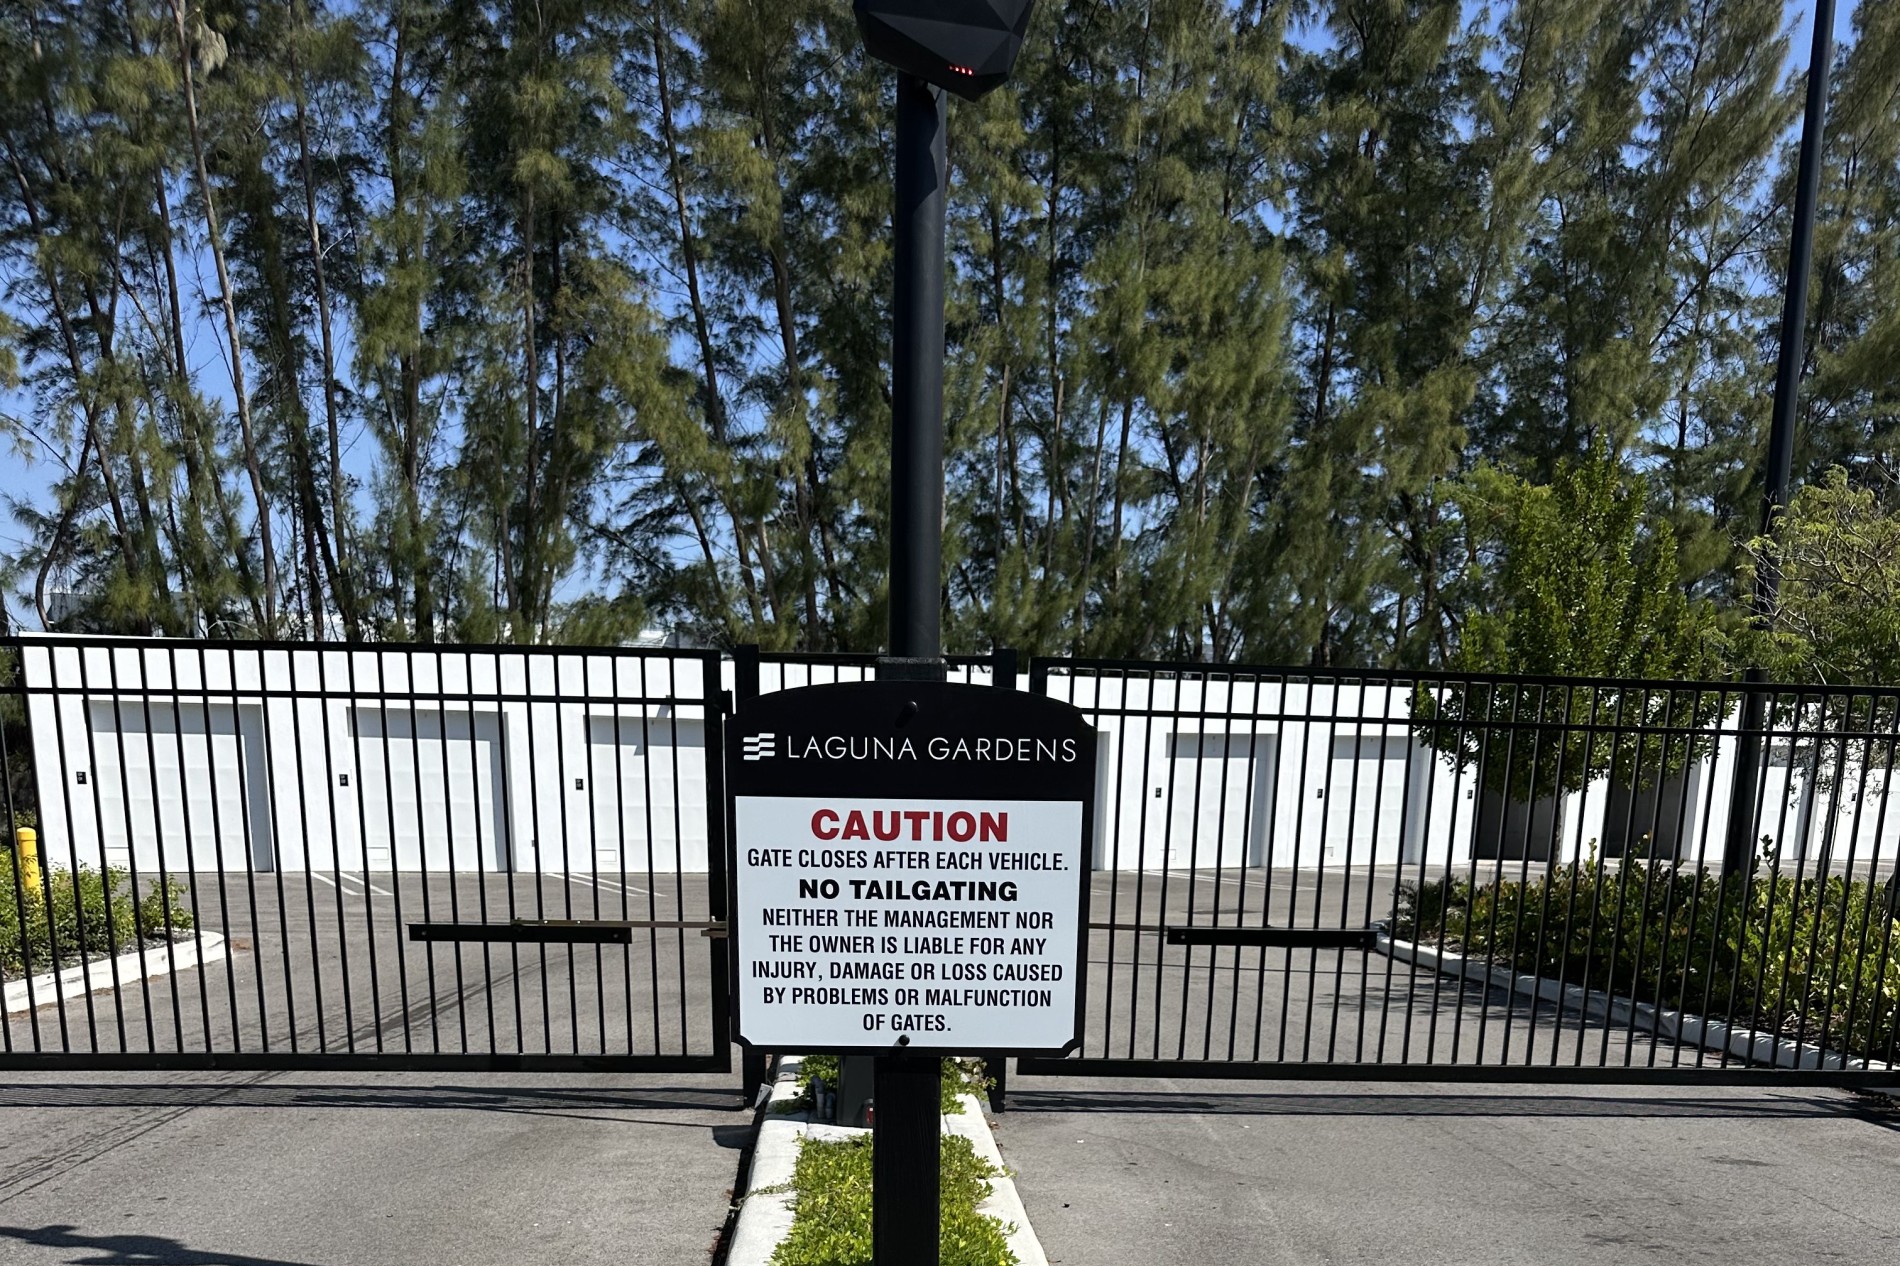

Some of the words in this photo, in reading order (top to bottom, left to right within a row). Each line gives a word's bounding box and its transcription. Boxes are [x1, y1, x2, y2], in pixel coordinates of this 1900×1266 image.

[788, 736, 916, 760] LAGUNA
[928, 738, 1076, 762] GARDENS
[812, 809, 1007, 842] CAUTION
[748, 849, 792, 867] GATE
[799, 850, 867, 868] CLOSES
[874, 851, 929, 869] AFTER
[937, 852, 982, 870] EACH
[989, 853, 1068, 870] VEHICLE.
[800, 879, 839, 899] NO
[849, 880, 1017, 901] TAILGATING
[763, 909, 838, 926] NEITHER
[844, 910, 877, 927] THE
[885, 910, 1010, 928] MANAGEMENT
[1016, 912, 1053, 929] NOR
[769, 935, 802, 952] THE
[810, 935, 874, 953] OWNER
[882, 937, 897, 953] IS
[905, 937, 963, 954] LIABLE
[970, 938, 1004, 955] FOR
[1010, 938, 1046, 955] ANY
[753, 961, 822, 981] INJURY,
[831, 962, 904, 979] DAMAGE
[911, 963, 934, 980] OR
[942, 963, 986, 980] LOSS
[994, 964, 1062, 981] CAUSED
[764, 987, 786, 1003] BY
[793, 988, 888, 1005] PROBLEMS
[895, 989, 918, 1005] OR
[926, 989, 1051, 1007] MALFUNCTION
[863, 1014, 885, 1030] OF
[891, 1014, 951, 1031] GATES.
